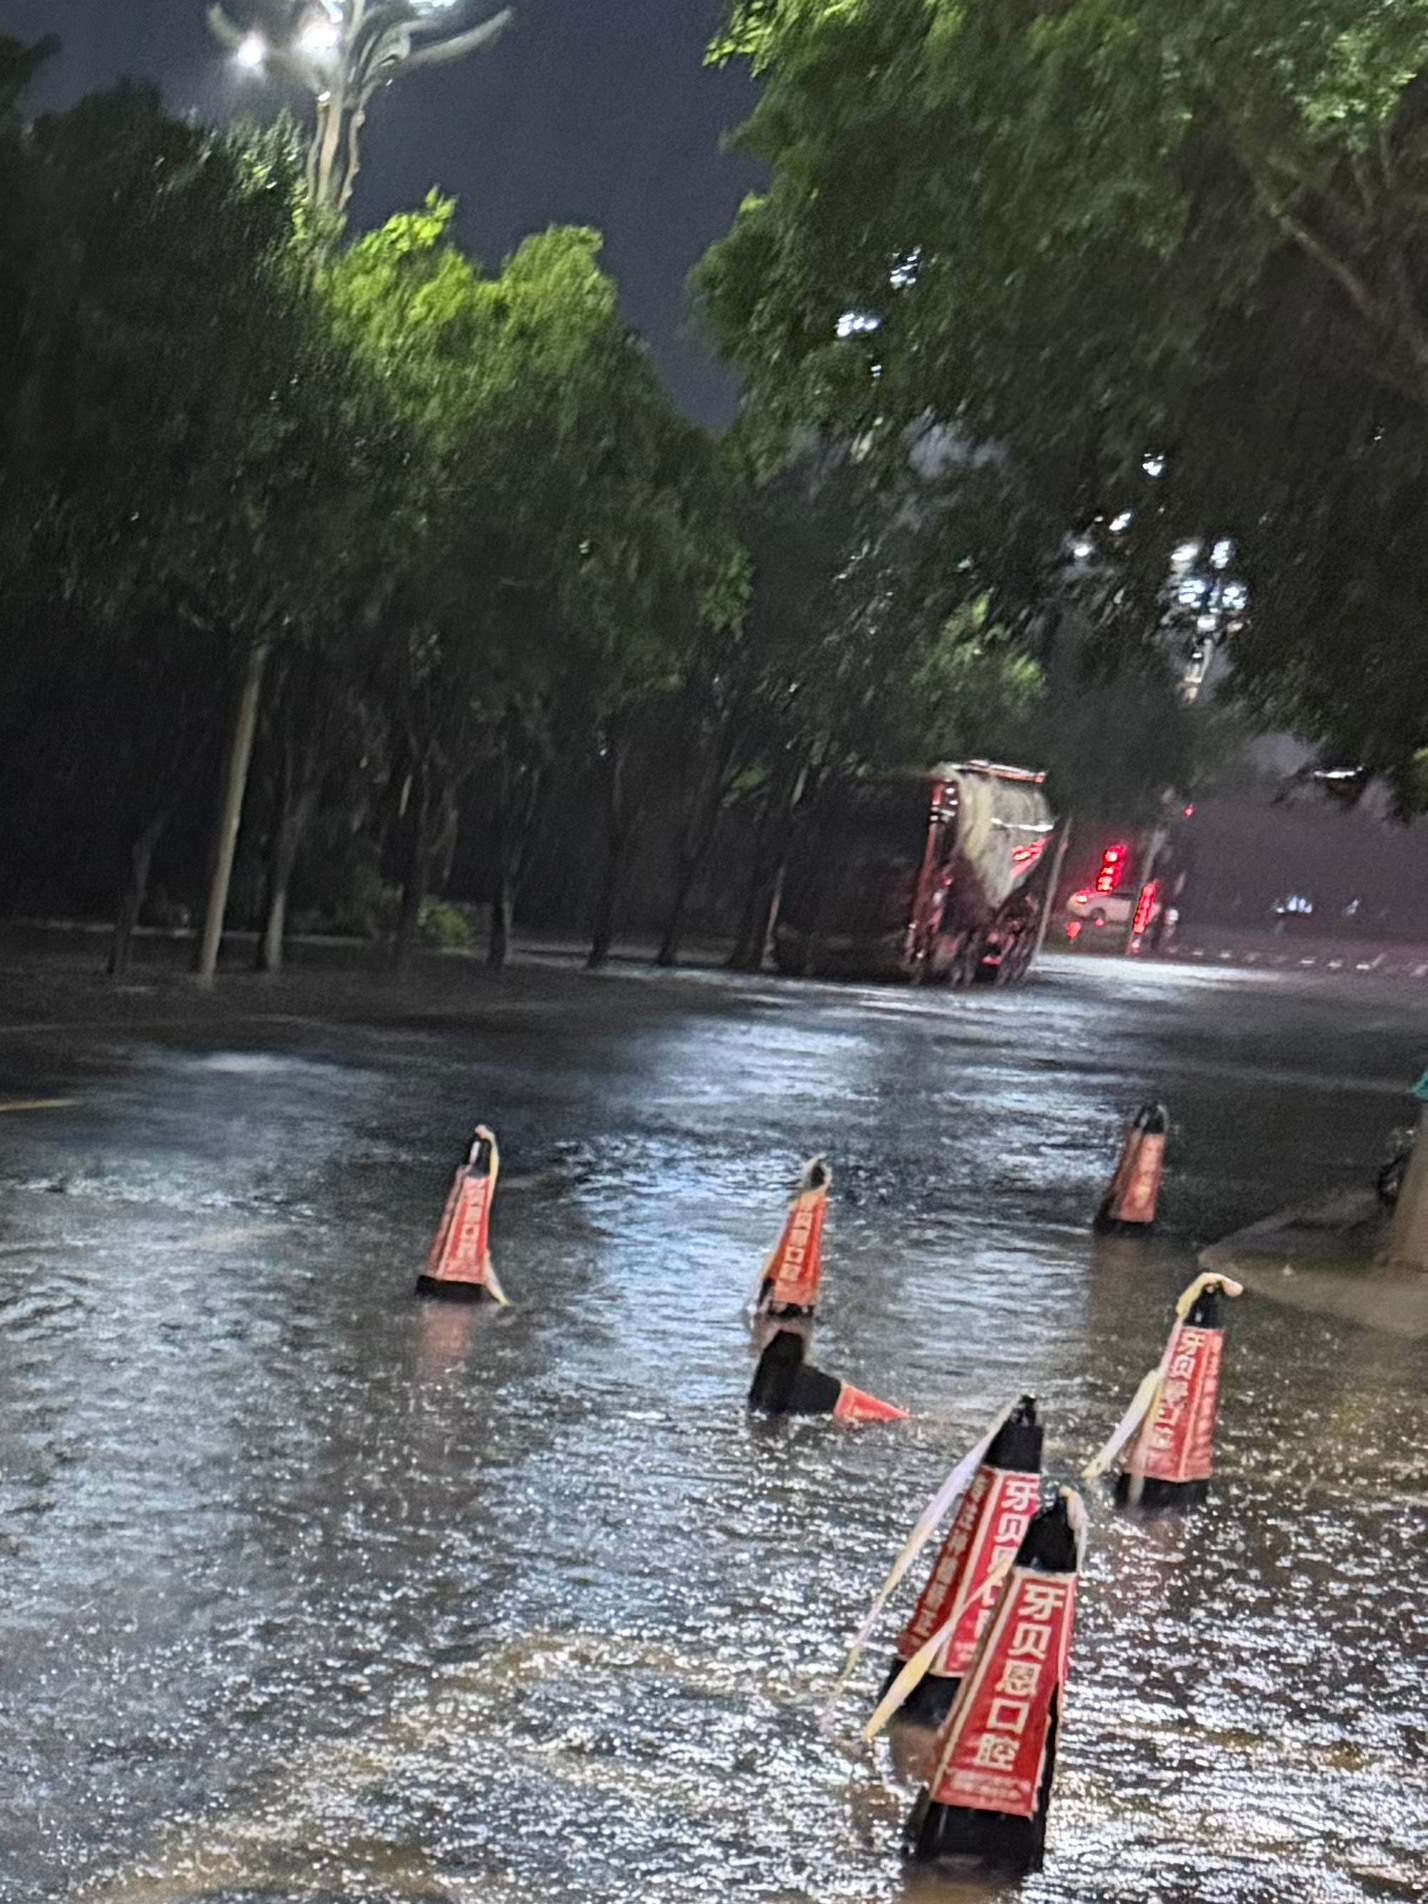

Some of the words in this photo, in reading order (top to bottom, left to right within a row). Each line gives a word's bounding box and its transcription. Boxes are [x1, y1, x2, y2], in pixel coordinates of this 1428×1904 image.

[973, 1582, 1067, 1772] 牙贝恩口腔
